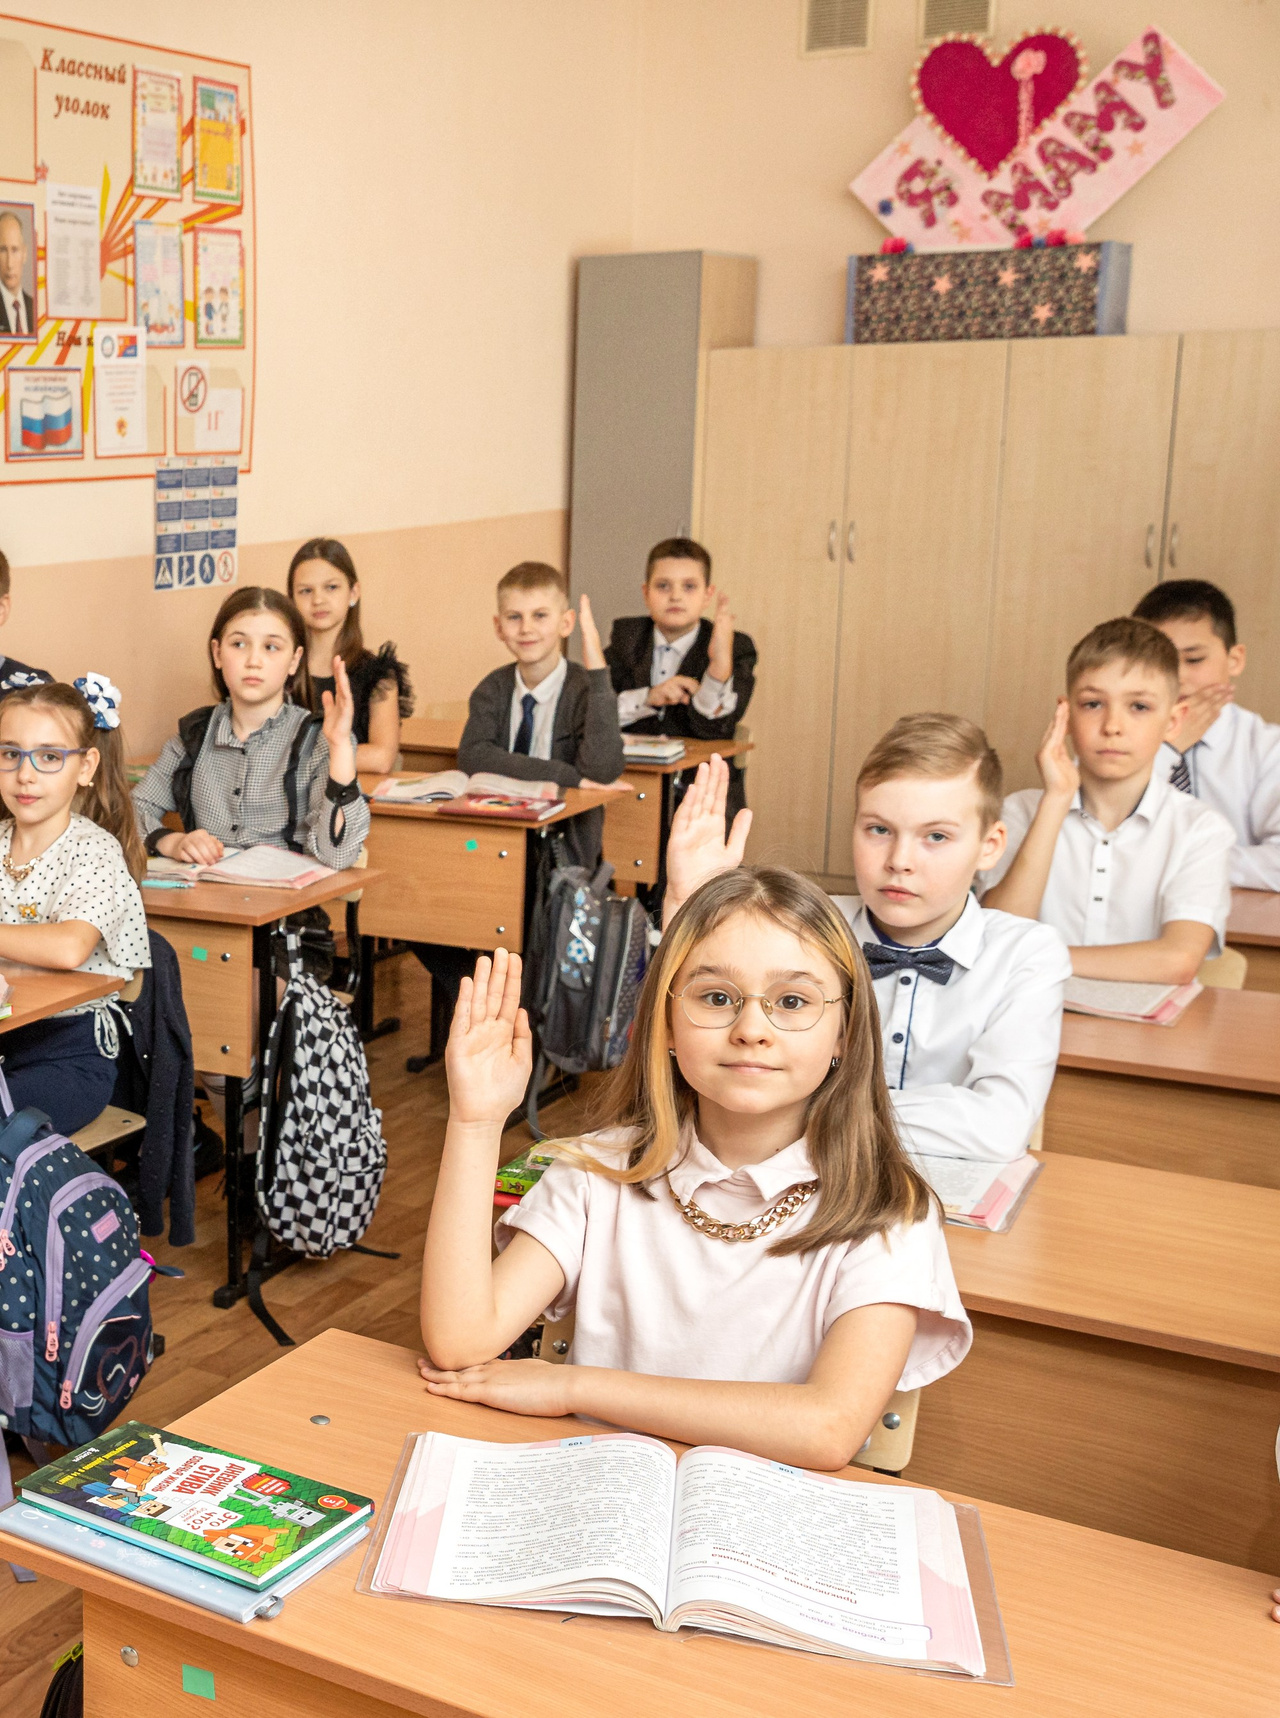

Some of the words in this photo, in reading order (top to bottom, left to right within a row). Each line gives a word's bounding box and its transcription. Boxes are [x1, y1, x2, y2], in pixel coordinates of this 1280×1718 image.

[41, 48, 127, 85] Классный
[54, 94, 111, 121] уголок
[895, 157, 960, 230] Я
[981, 31, 1177, 238] МАМУ
[171, 1464, 221, 1495] СТИВА
[172, 1455, 204, 1476] СОБАЧЬЯ
[200, 1462, 246, 1497] ДНЕВНИК
[151, 1474, 179, 1492] ЖИЗНЬ
[712, 1553, 777, 1577] Электроника
[784, 1576, 857, 1604] Приключения
